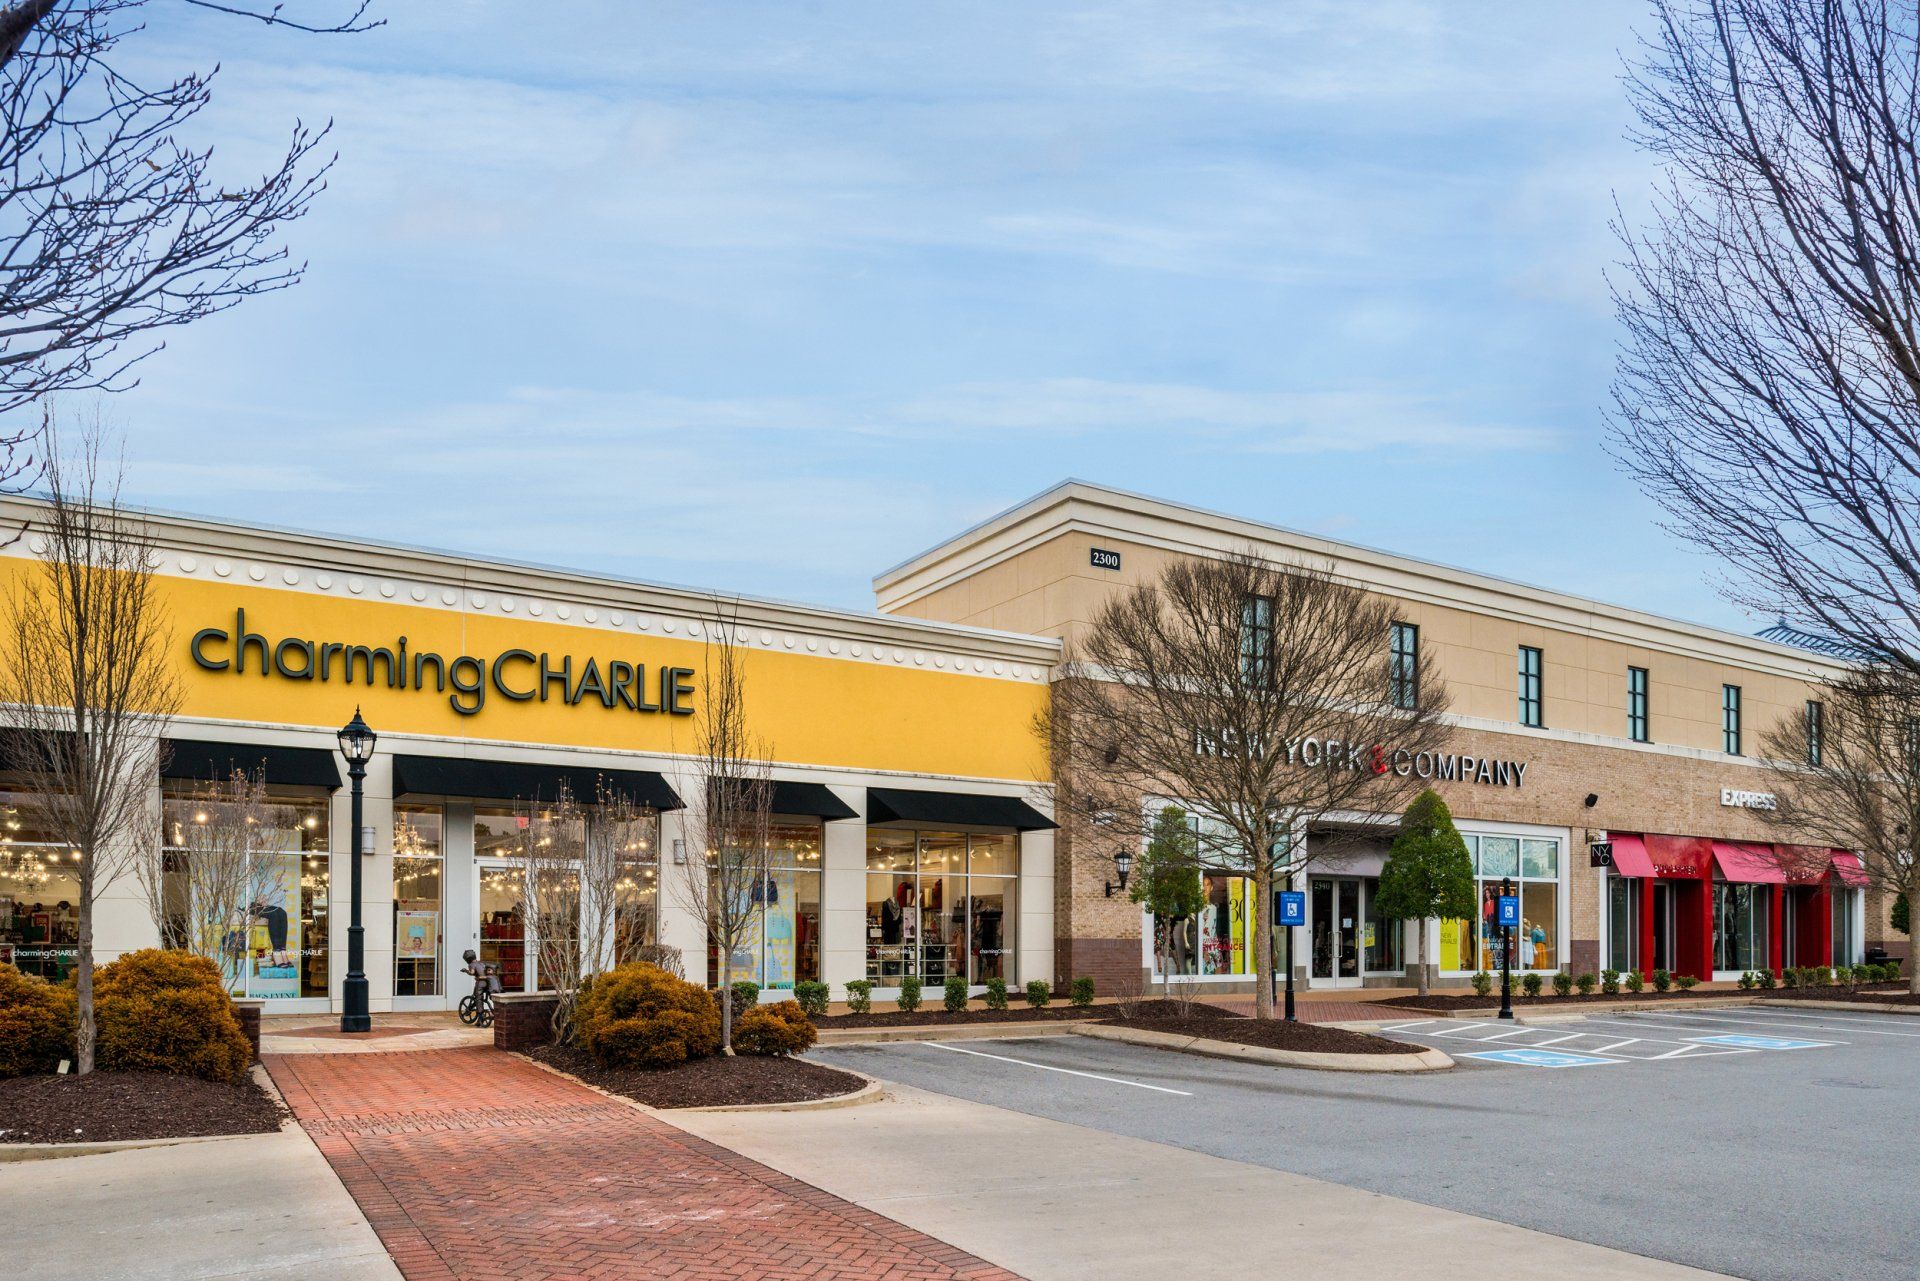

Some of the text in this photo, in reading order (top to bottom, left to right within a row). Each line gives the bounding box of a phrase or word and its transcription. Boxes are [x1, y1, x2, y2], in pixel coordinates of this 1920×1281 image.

[1093, 552, 1118, 567] 2300
[1196, 726, 1270, 760] NEW
[1282, 735, 1364, 772] YORK
[1394, 747, 1528, 787] COMPANY
[1721, 789, 1776, 810] EXPRESS
